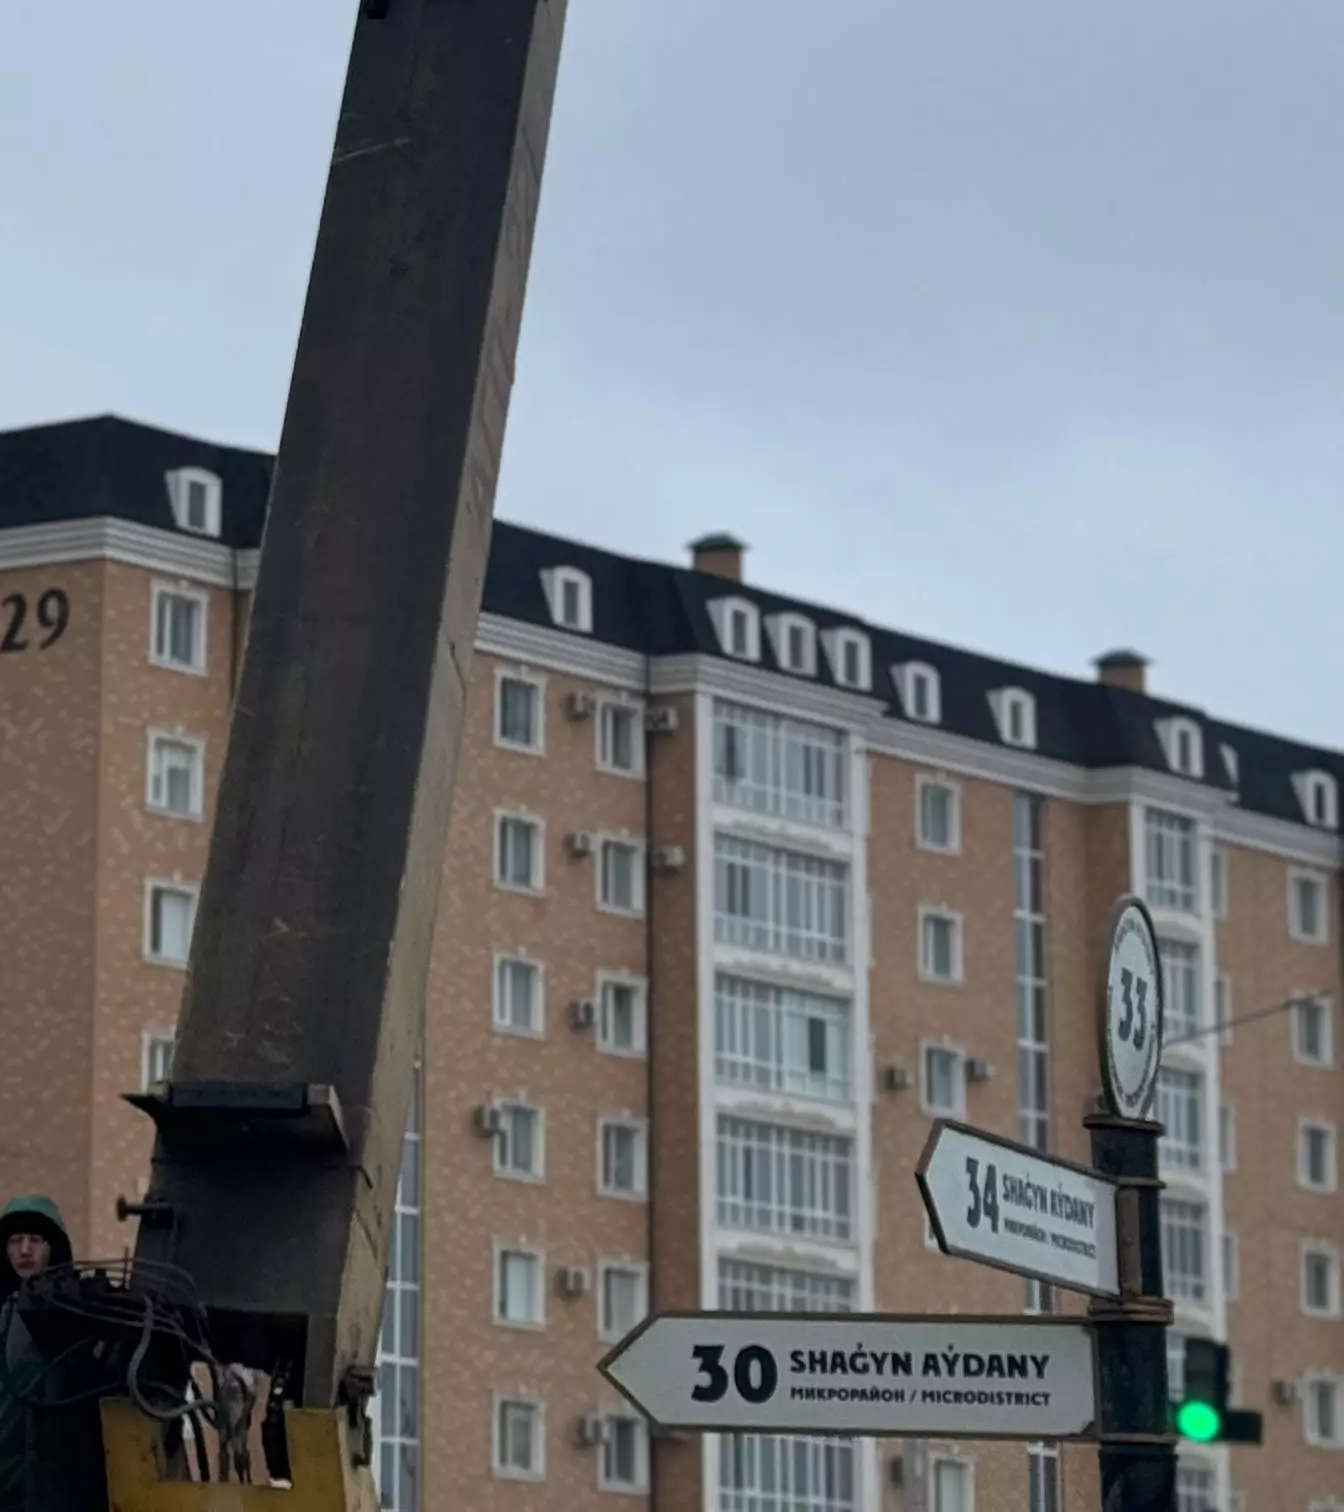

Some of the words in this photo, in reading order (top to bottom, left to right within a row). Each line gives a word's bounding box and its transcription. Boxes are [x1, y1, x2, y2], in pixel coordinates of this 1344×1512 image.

[1118, 967, 1148, 1051] 33
[965, 1156, 1001, 1235] 34
[690, 1343, 779, 1404] 30
[789, 1385, 906, 1403] МИКРОРАЙОН
[921, 1390, 1052, 1407] MICRODISTRICT
